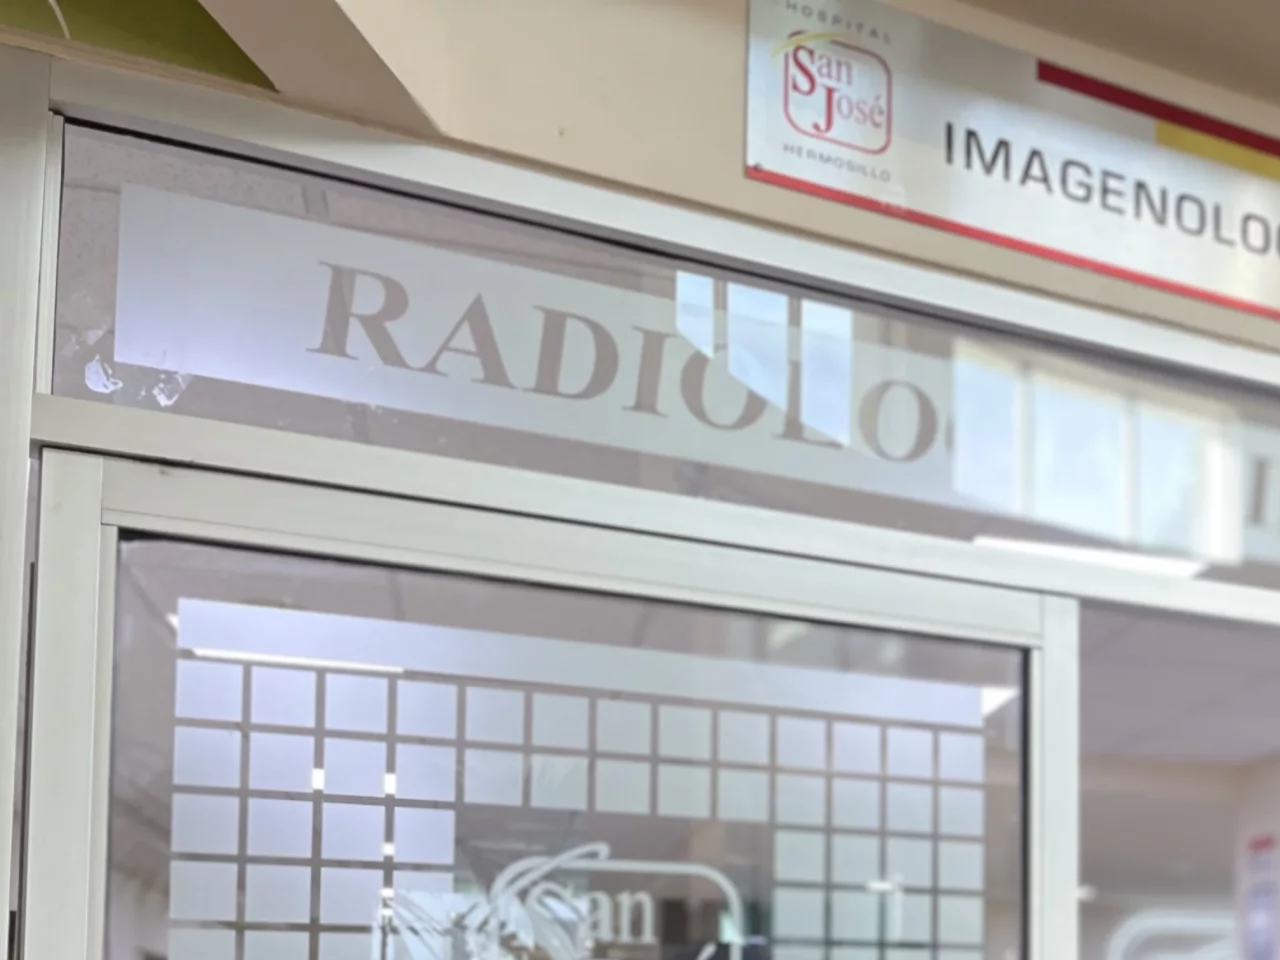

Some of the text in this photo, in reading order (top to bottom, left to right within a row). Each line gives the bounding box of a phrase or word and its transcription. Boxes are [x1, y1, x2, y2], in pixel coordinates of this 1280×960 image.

[786, 0, 891, 45] HOSPITAL
[792, 44, 853, 96] San
[812, 83, 885, 134] José
[783, 142, 892, 183] HERMOSILLO
